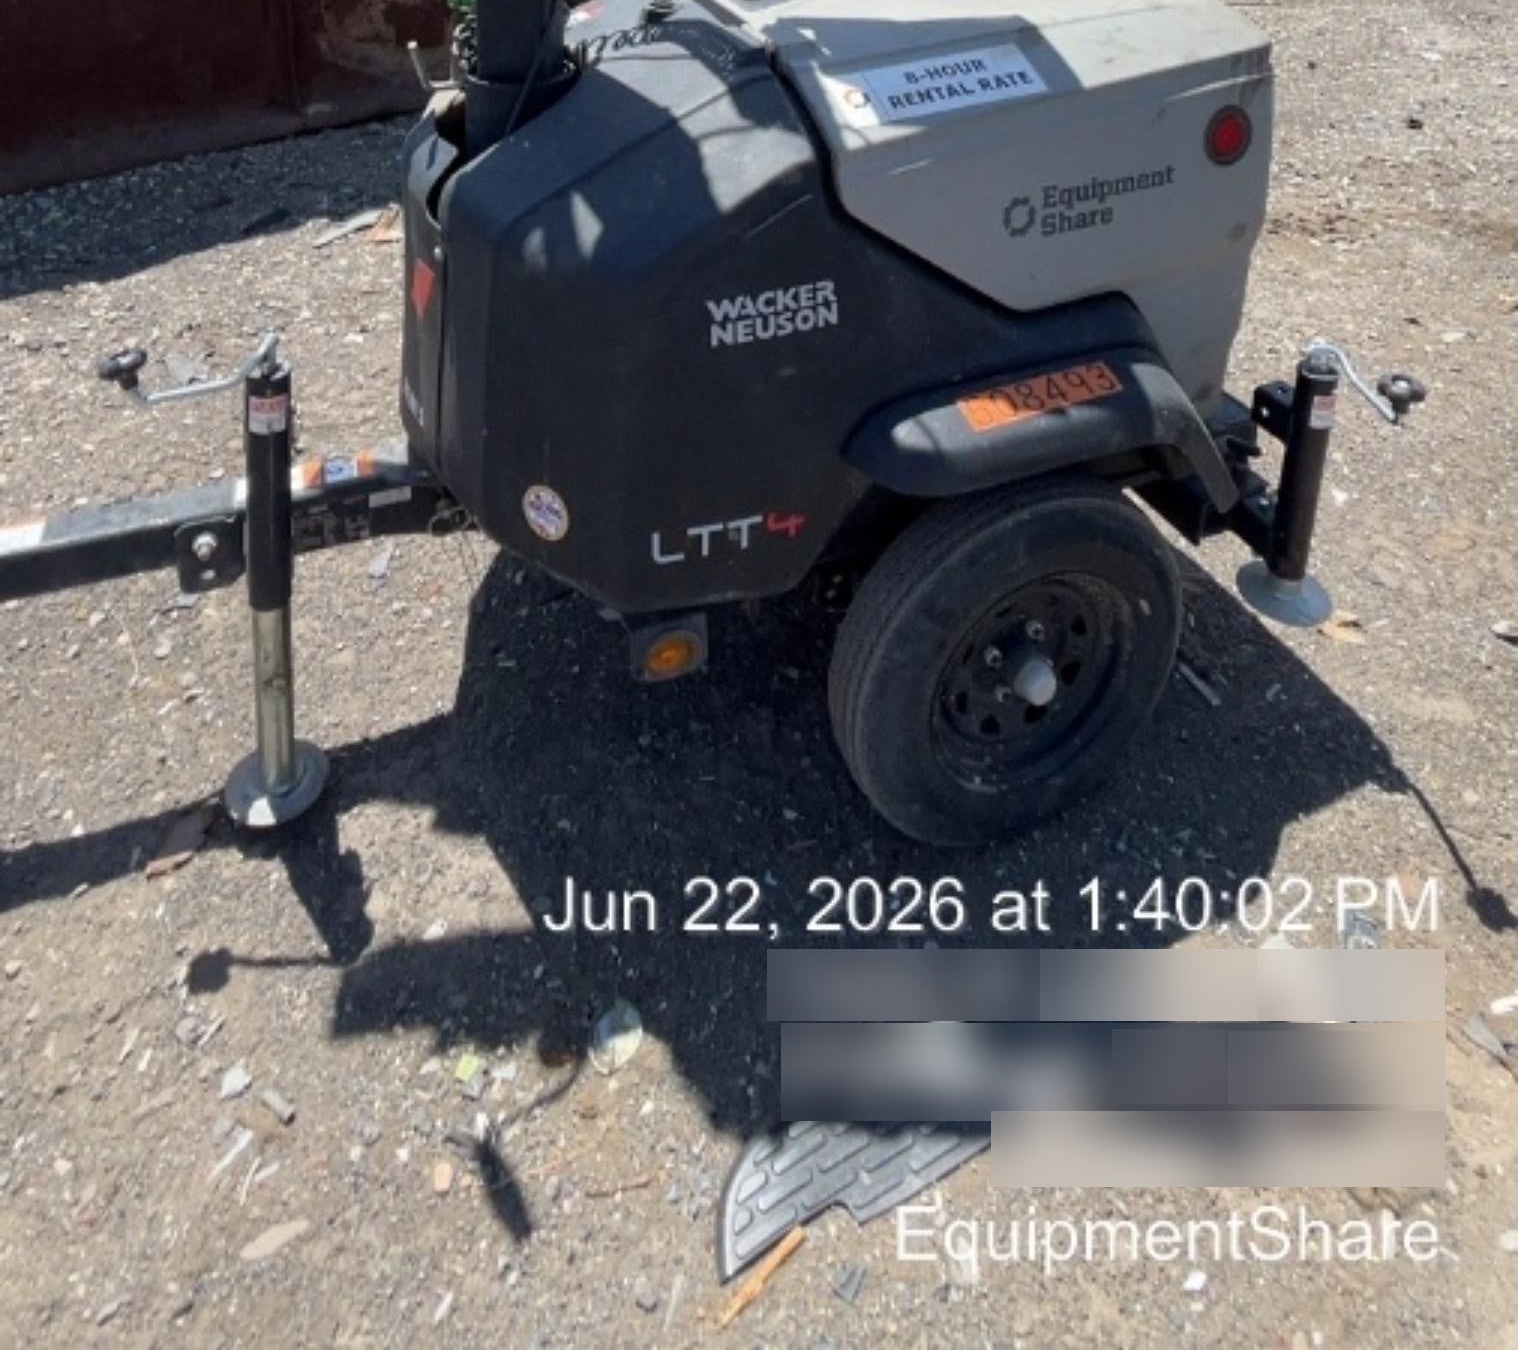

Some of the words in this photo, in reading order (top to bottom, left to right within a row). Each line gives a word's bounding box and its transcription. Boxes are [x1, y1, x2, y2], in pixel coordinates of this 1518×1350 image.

[887, 82, 975, 110] RENTAL
[977, 70, 1034, 92] RATE
[1041, 164, 1176, 210] Equipment
[1041, 206, 1114, 238] Share
[706, 279, 838, 323] WACKER
[710, 301, 838, 348] NEUSON
